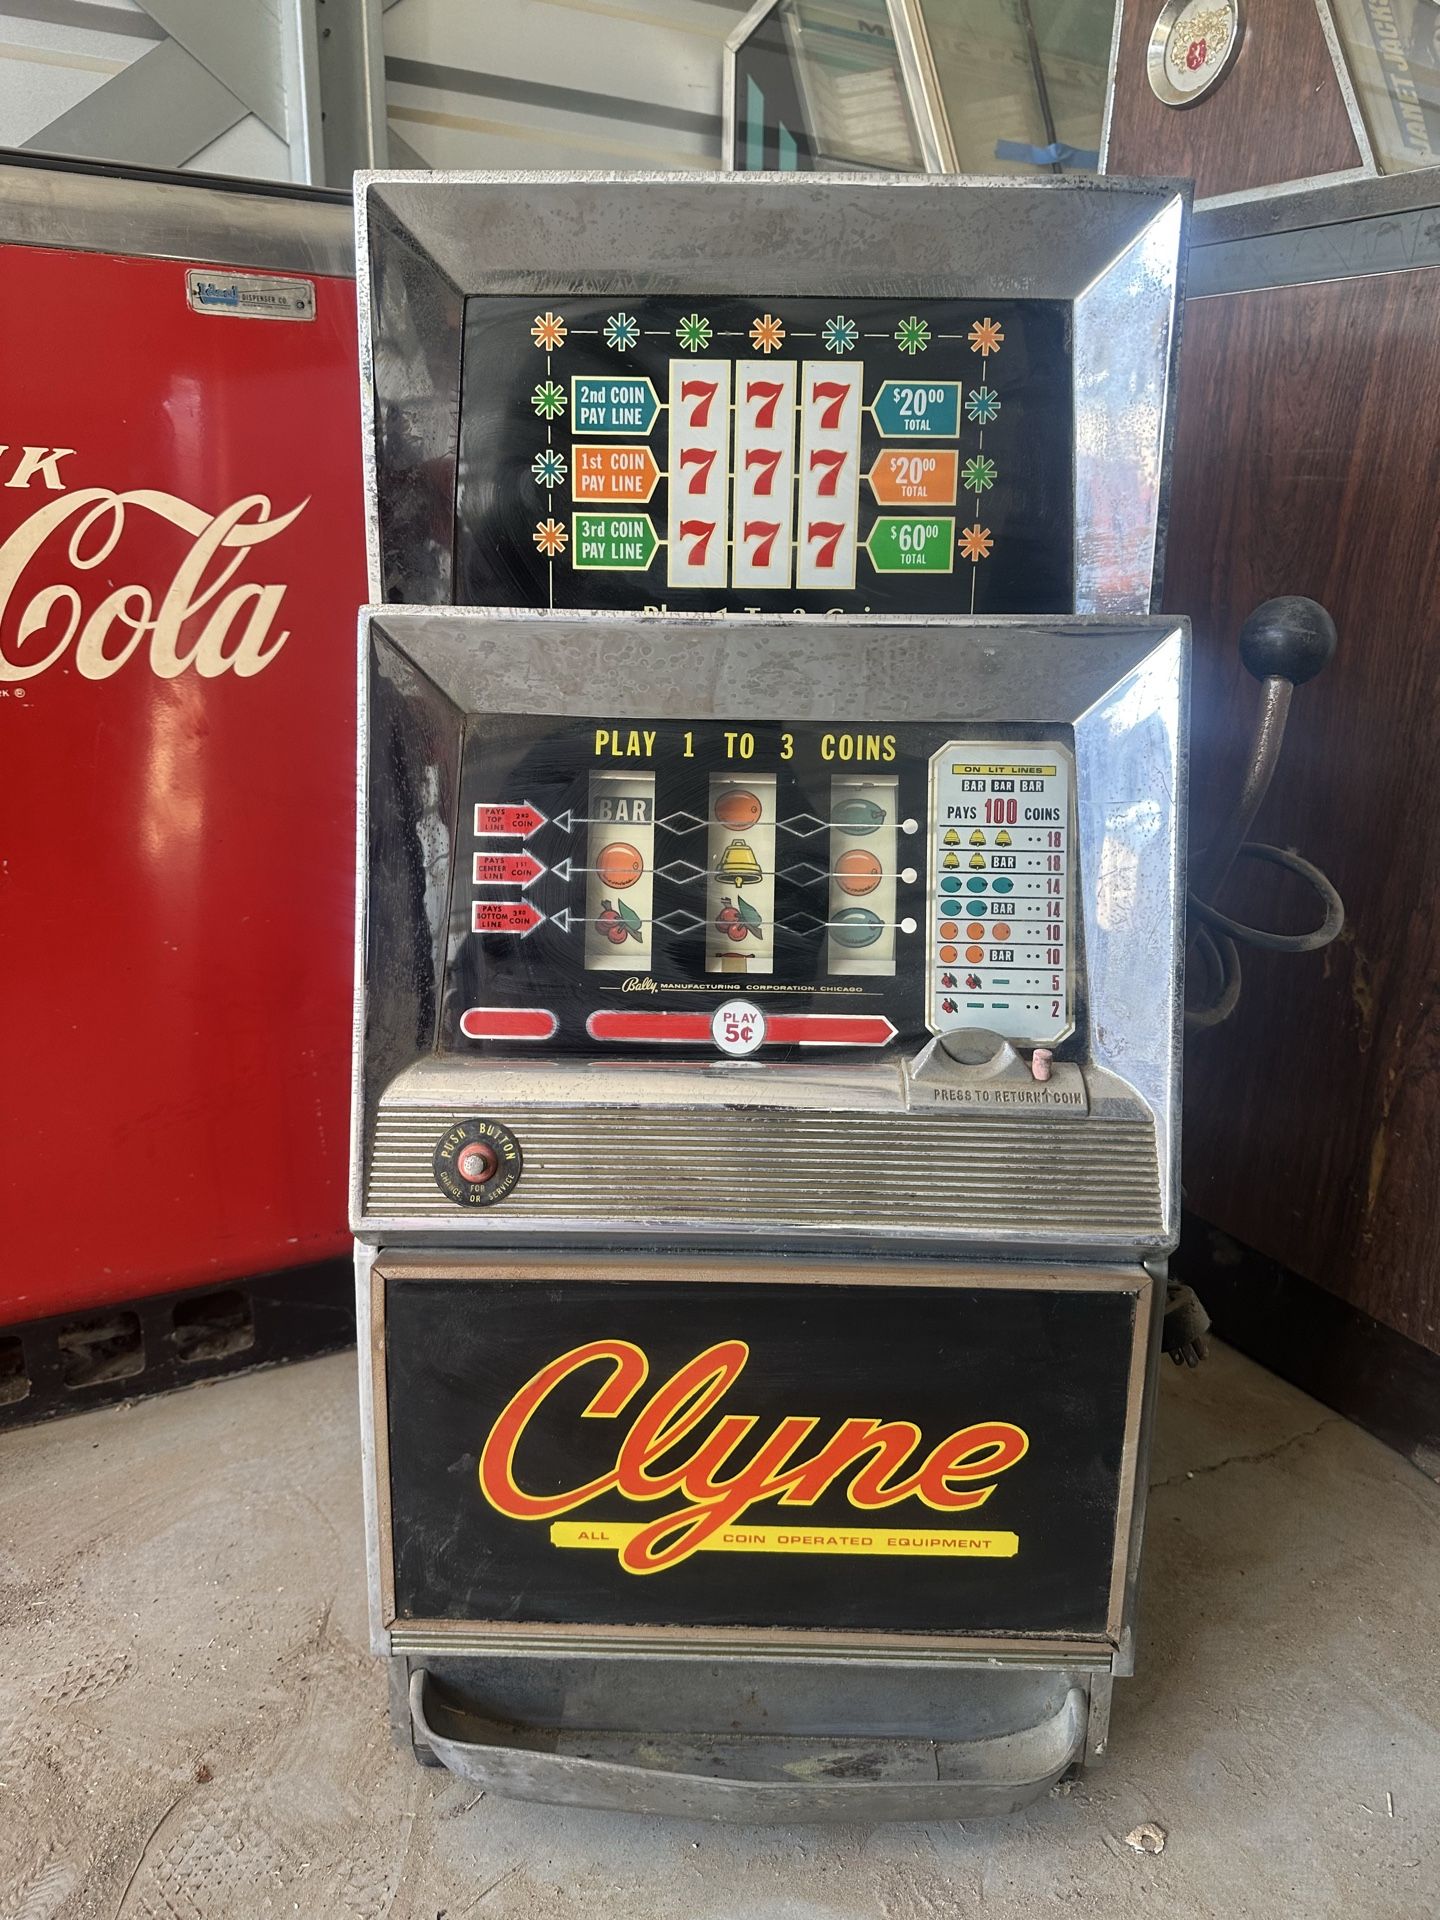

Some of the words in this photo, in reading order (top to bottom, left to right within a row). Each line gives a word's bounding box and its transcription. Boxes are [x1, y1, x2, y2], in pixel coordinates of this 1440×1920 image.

[1390, 73, 1430, 151] JANET
[242, 293, 276, 303] DISPENSER
[581, 386, 606, 404] 2nd
[610, 386, 645, 404] COIN
[681, 380, 719, 428] 7
[746, 381, 784, 428] 7
[813, 381, 851, 429] 7
[581, 408, 606, 425] PAY
[612, 408, 643, 425] LINE
[904, 419, 931, 431] TOTAL
[581, 453, 603, 469] 1st
[610, 454, 645, 470] COIN
[680, 447, 717, 494] 7
[745, 448, 783, 495] 7
[810, 449, 848, 496] 7
[581, 475, 606, 492] PAY
[612, 476, 643, 493] LINE
[901, 486, 928, 497] TOTAL
[582, 521, 605, 537] 3rd
[610, 522, 644, 538] COIN
[582, 542, 606, 559] PAY
[612, 543, 643, 560] LINE
[680, 519, 716, 566] 7
[744, 520, 781, 567] 7
[808, 521, 845, 568] 7
[900, 553, 927, 565] TOTAL
[0, 487, 311, 682] Cola
[595, 729, 657, 757] PLAY
[683, 731, 695, 758] 1
[724, 732, 755, 759] TO
[780, 733, 794, 760] 3
[821, 734, 896, 761] COINS
[963, 780, 985, 791] BAR
[994, 781, 1012, 791] BAR
[1022, 781, 1042, 791] BAR
[601, 799, 648, 822] BAR
[947, 806, 977, 820] PAYS
[985, 798, 1018, 824] 100
[1024, 807, 1060, 821] COINS
[1047, 831, 1061, 848] 18
[993, 856, 1014, 868] BAR
[1047, 855, 1061, 871] 18
[1046, 878, 1060, 895] 14
[992, 903, 1013, 914] BAR
[1046, 901, 1060, 918] 14
[1046, 924, 1060, 941] 10
[991, 950, 1012, 961] BAR
[1046, 948, 1060, 965] 10
[1052, 975, 1060, 991] 5
[1052, 1000, 1060, 1018] 2
[723, 1012, 757, 1024] PLAY
[725, 1023, 754, 1043] 5¢
[934, 1089, 972, 1101] PRESS
[975, 1090, 989, 1101] TO
[995, 1090, 1041, 1103] RETURN
[1053, 1092, 1082, 1105] COIN
[441, 1128, 466, 1158] PUSH
[480, 1123, 516, 1160] BUTTON
[440, 1171, 463, 1198] CHANGE
[469, 1194, 481, 1203] OR
[488, 1173, 515, 1201] SERVICE
[470, 1184, 485, 1192] FOR
[479, 1339, 1029, 1575] Clyne
[578, 1530, 610, 1541] ALL
[723, 1534, 767, 1544] COIN
[777, 1535, 873, 1547] OPERATED
[886, 1537, 992, 1549] EQUIPMENT
